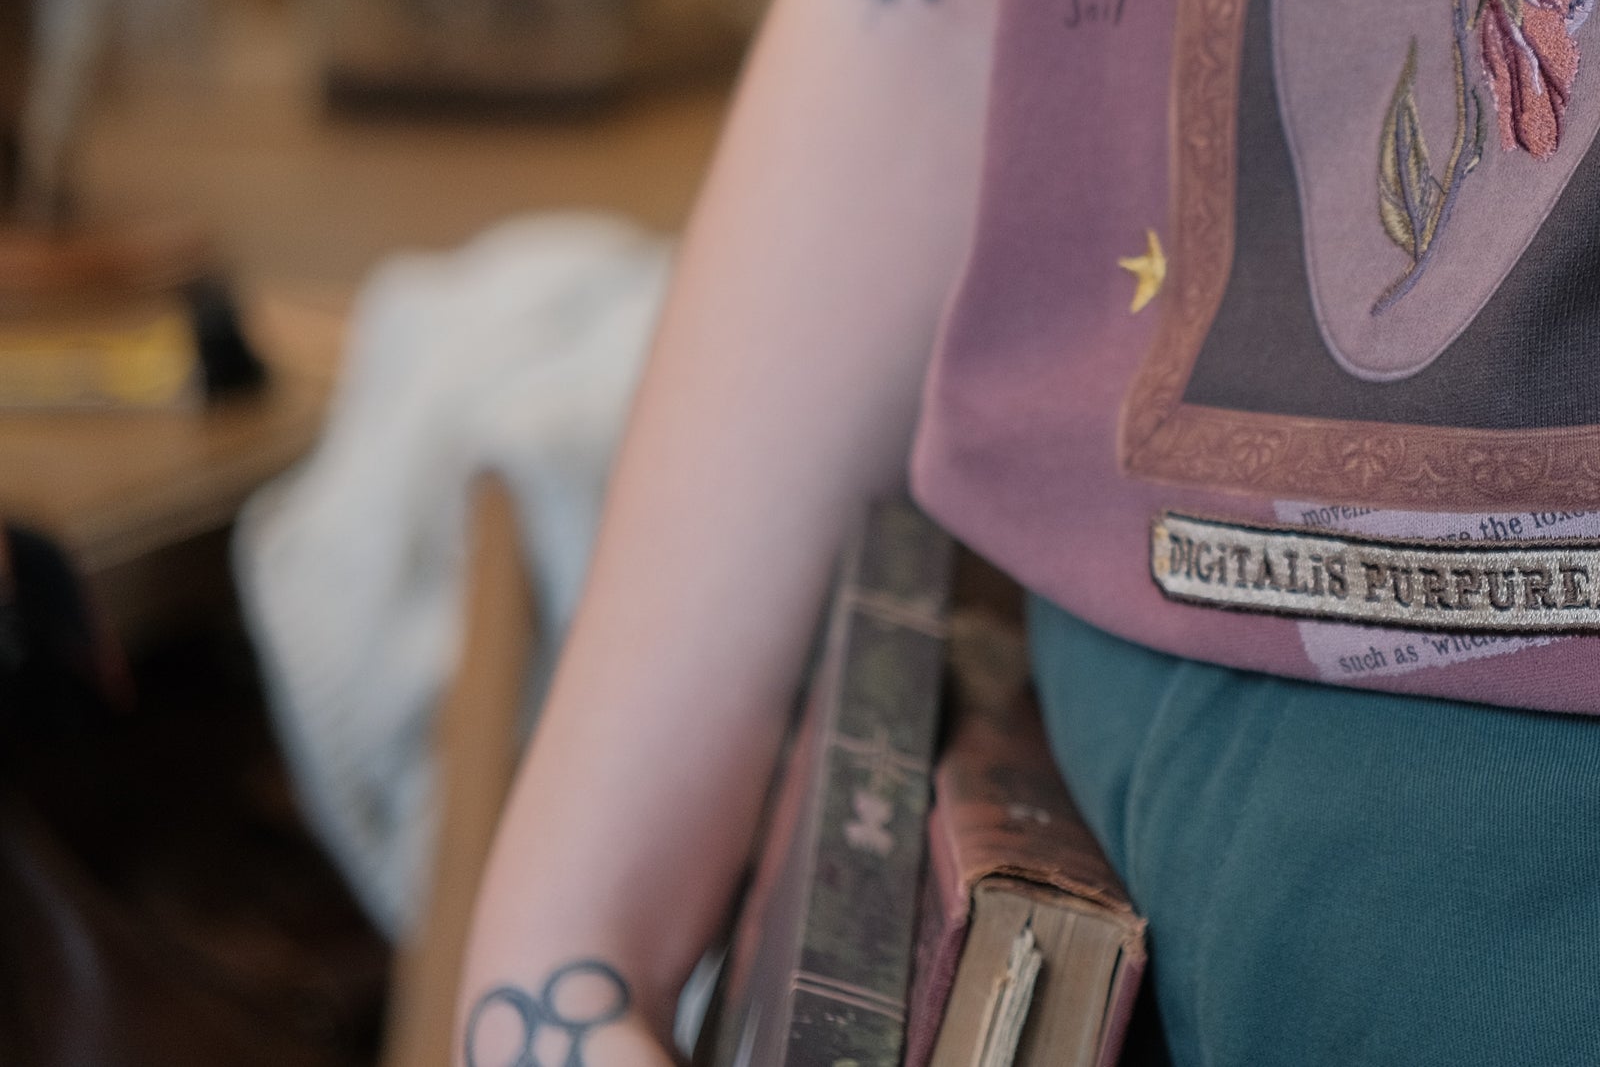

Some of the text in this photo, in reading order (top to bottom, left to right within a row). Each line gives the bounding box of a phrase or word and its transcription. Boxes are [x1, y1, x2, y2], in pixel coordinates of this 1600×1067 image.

[1479, 516, 1523, 540] the
[1338, 645, 1388, 675] such
[1394, 645, 1420, 665] as
